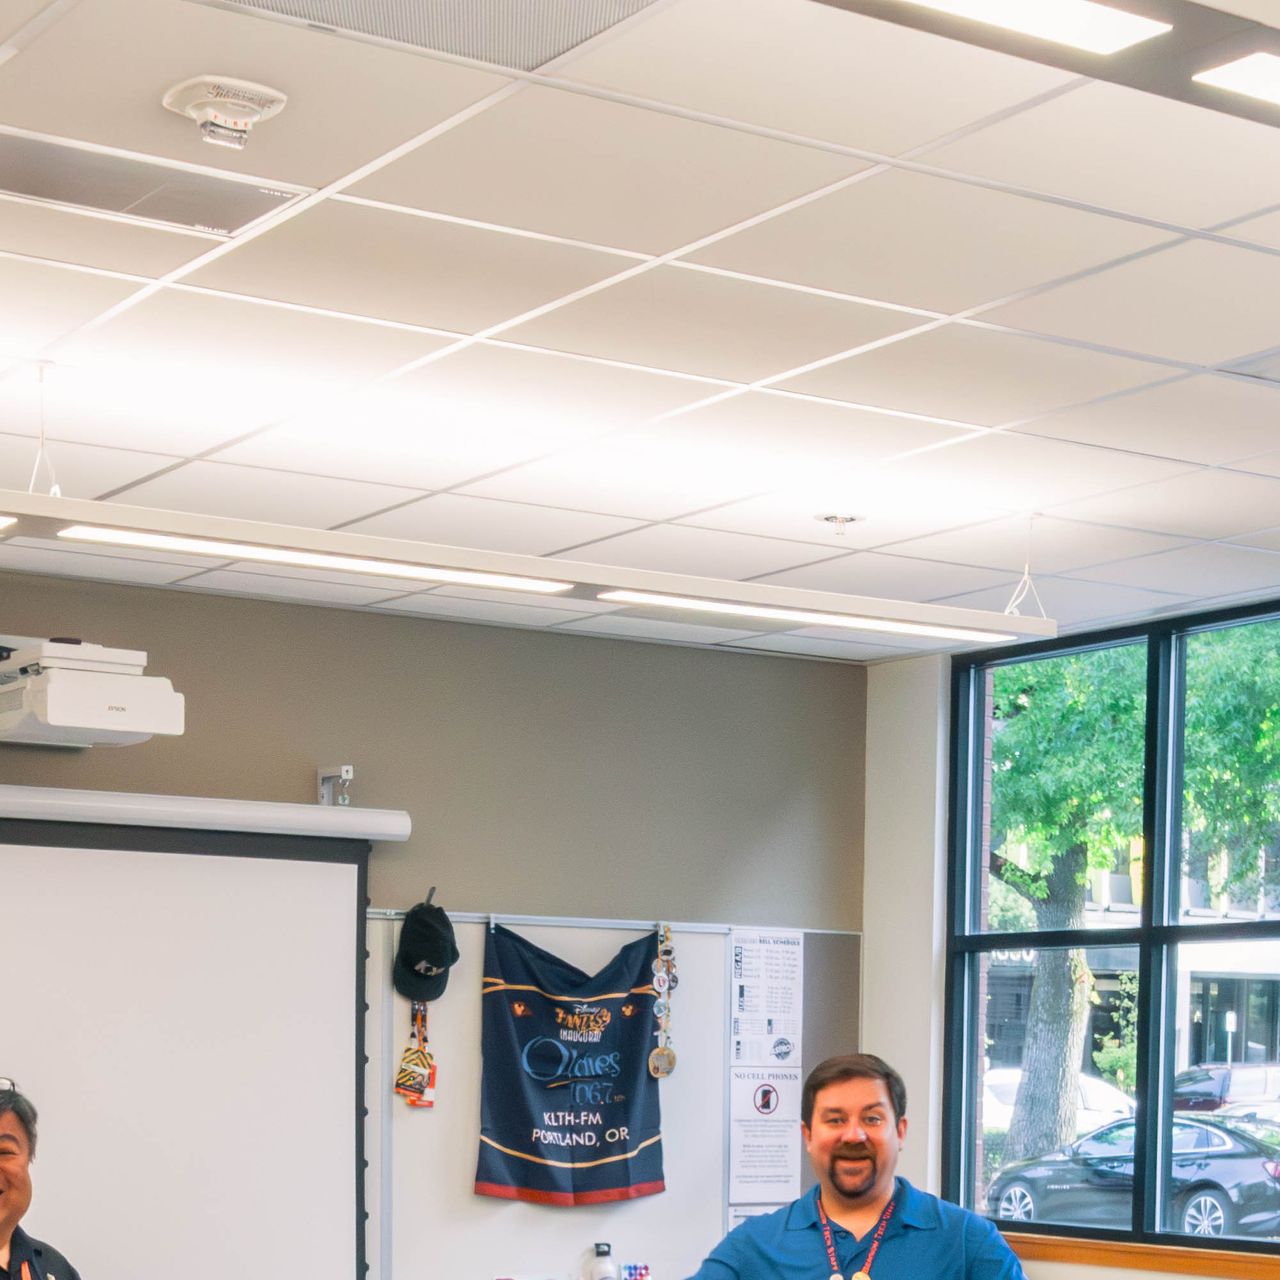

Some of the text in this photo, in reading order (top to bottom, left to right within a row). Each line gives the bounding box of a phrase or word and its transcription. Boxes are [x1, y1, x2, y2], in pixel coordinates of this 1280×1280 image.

[768, 1073, 799, 1081] PHONES
[543, 1112, 602, 1126] KLTH-FM
[532, 1127, 630, 1147] PORTLAND, OR
